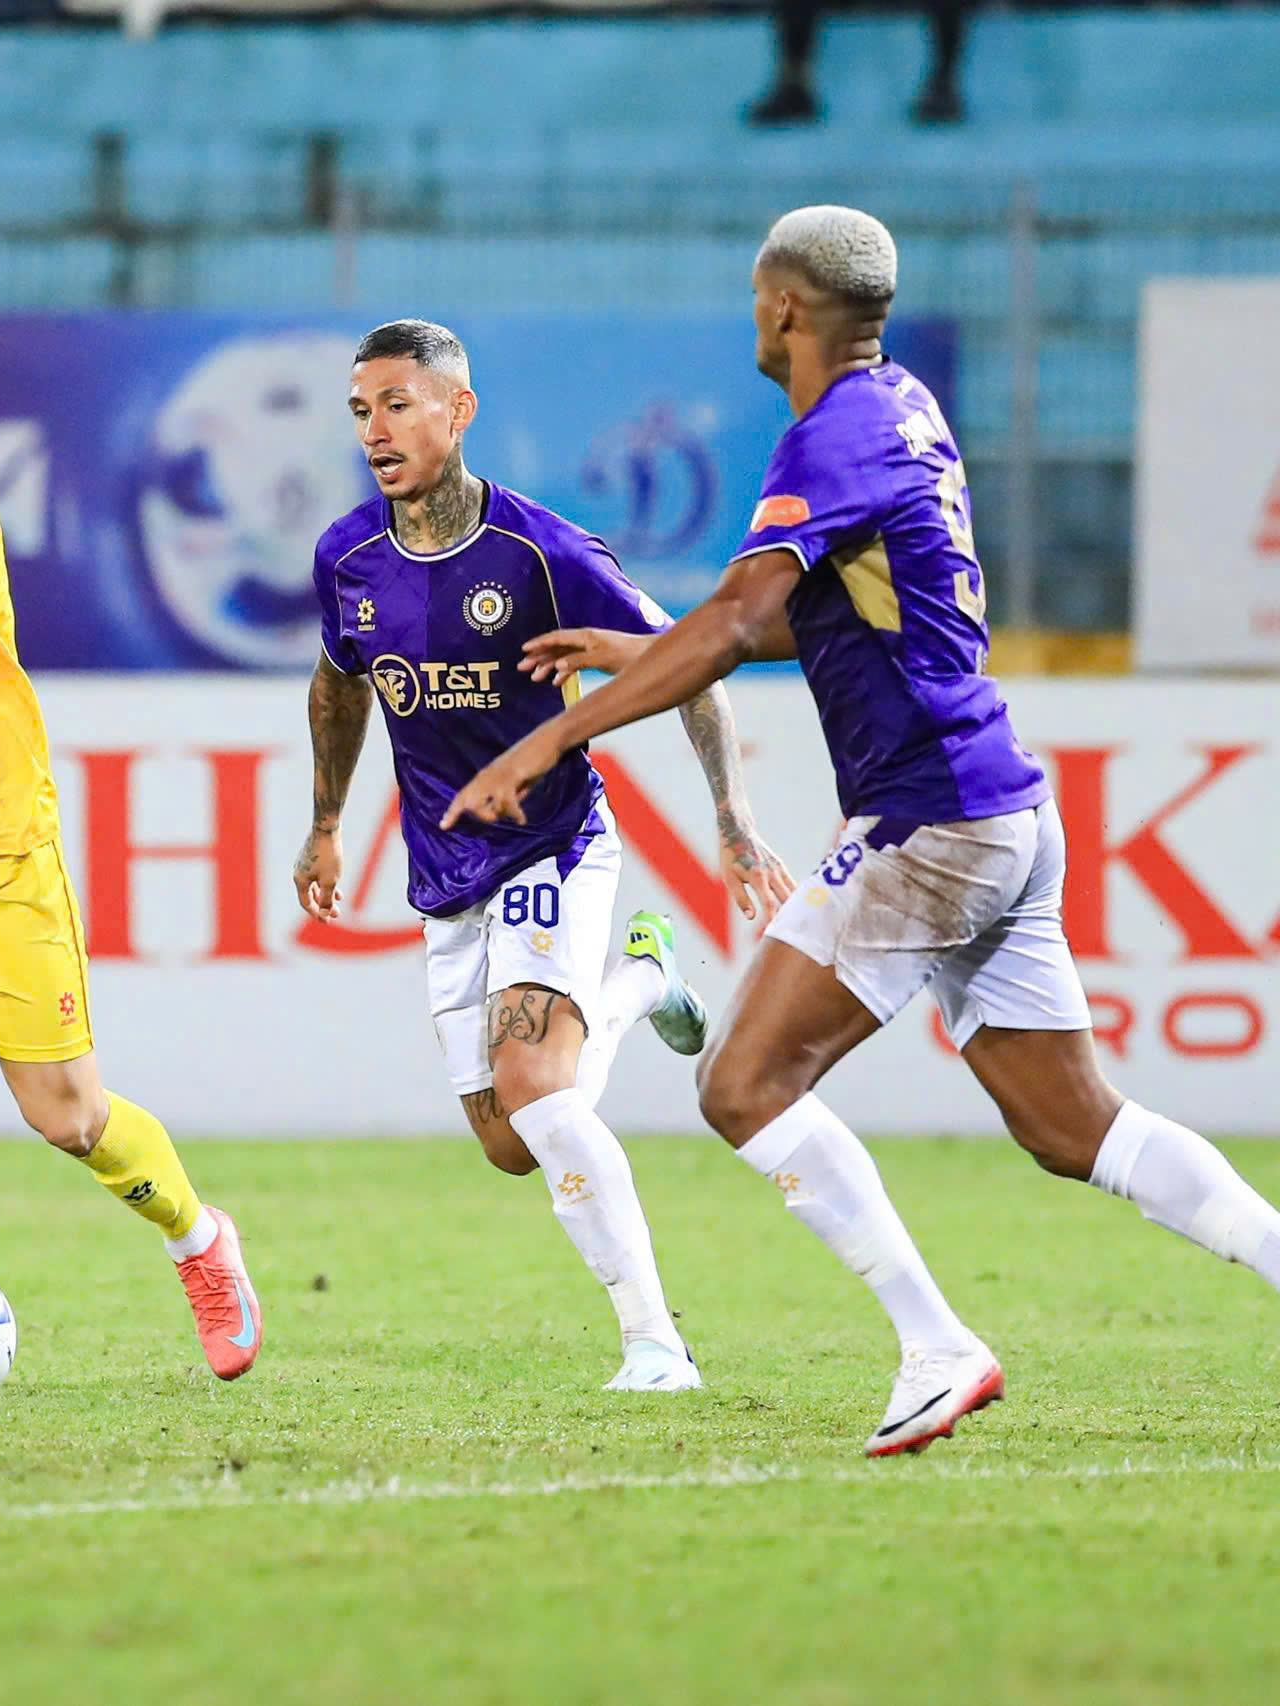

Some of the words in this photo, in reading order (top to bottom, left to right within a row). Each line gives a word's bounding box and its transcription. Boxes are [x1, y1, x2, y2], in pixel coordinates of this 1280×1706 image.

[420, 661, 500, 692] T&T
[424, 692, 501, 710] HOMES
[503, 883, 559, 929] 80
[928, 992, 1266, 1062] RO
